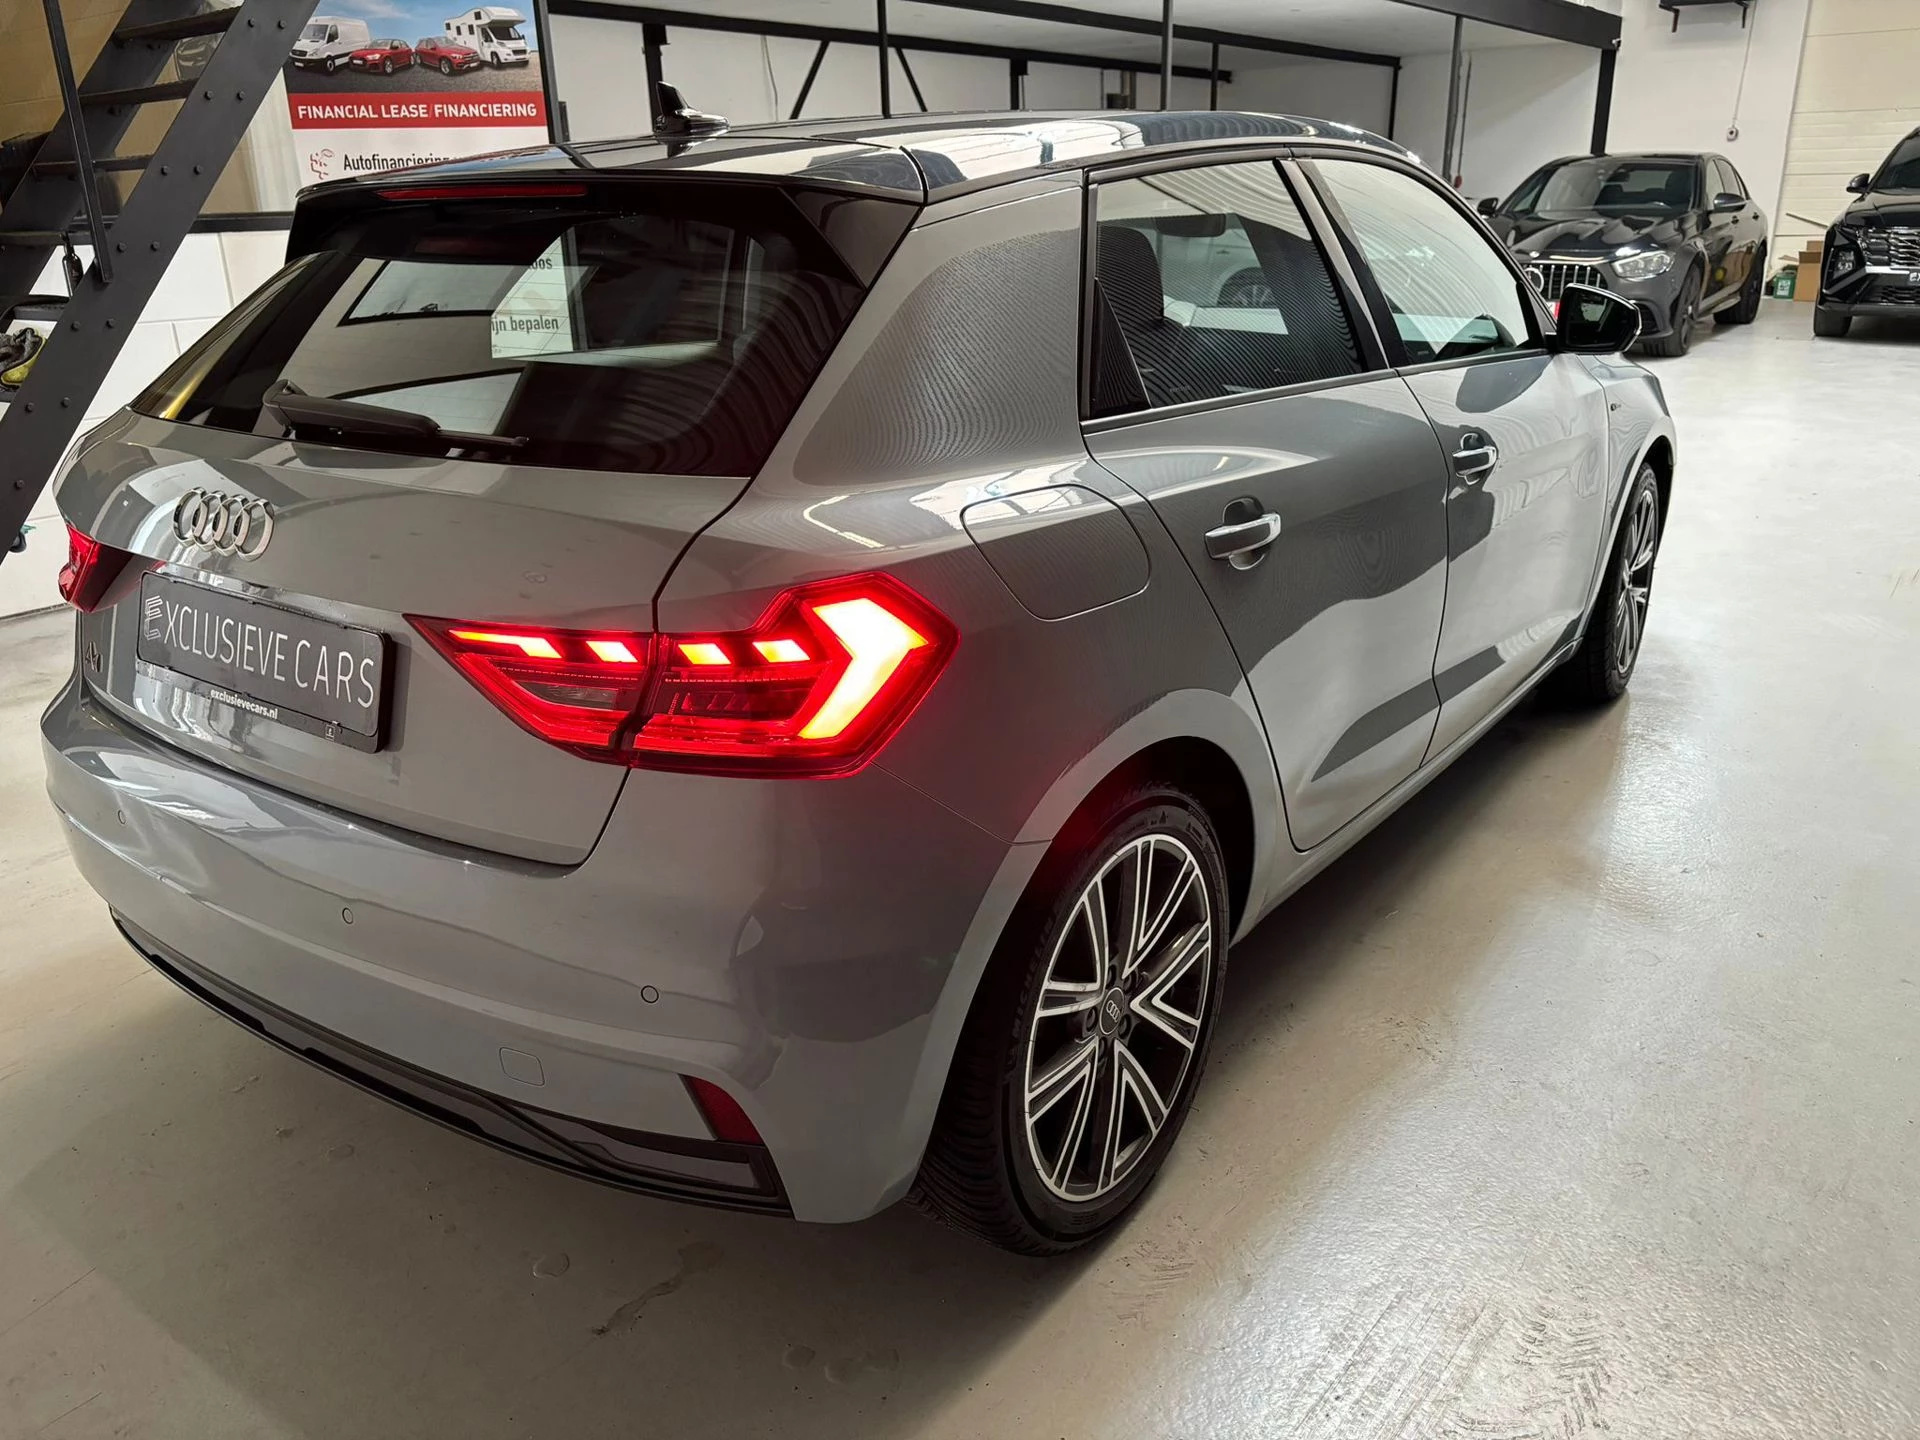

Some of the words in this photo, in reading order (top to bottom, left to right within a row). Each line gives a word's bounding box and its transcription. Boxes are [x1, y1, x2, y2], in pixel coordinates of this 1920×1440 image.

[298, 104, 379, 119] FINANCIAL
[381, 104, 428, 118] LEASE
[434, 103, 537, 118] FINANCIERING
[343, 152, 450, 171] Autofinancieri
[510, 315, 559, 334] bepalen
[295, 639, 374, 709] CARS
[210, 689, 278, 720] exclusievecars.nl
